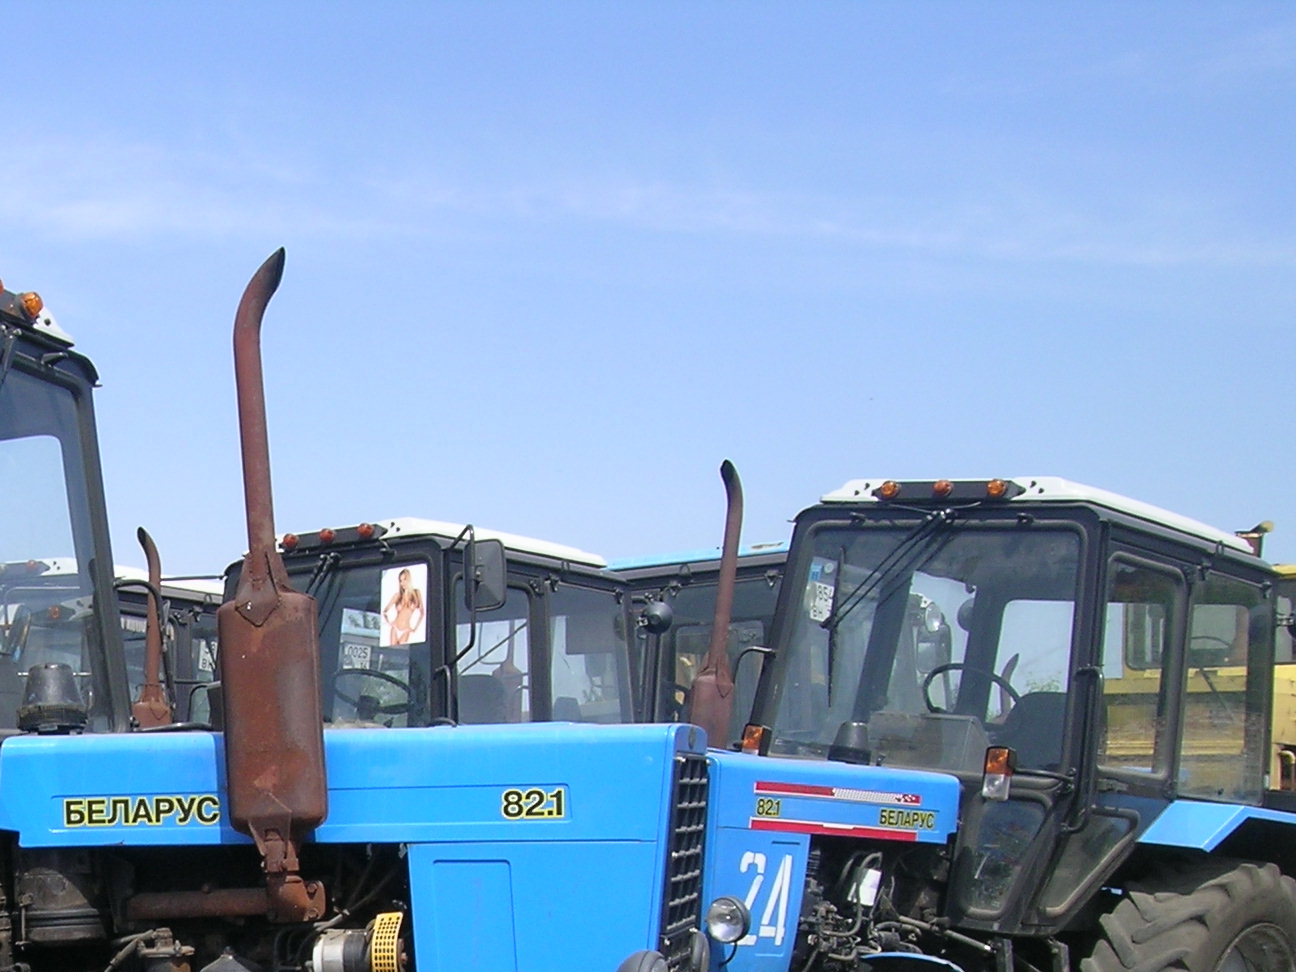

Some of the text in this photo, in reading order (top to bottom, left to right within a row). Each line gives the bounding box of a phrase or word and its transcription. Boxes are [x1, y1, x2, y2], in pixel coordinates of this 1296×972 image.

[63, 795, 221, 827] БЕЛАРУС
[502, 788, 565, 819] 82.1
[755, 797, 781, 818] 82.1
[878, 808, 935, 830] БЕЛАРУС
[732, 851, 793, 947] 24
